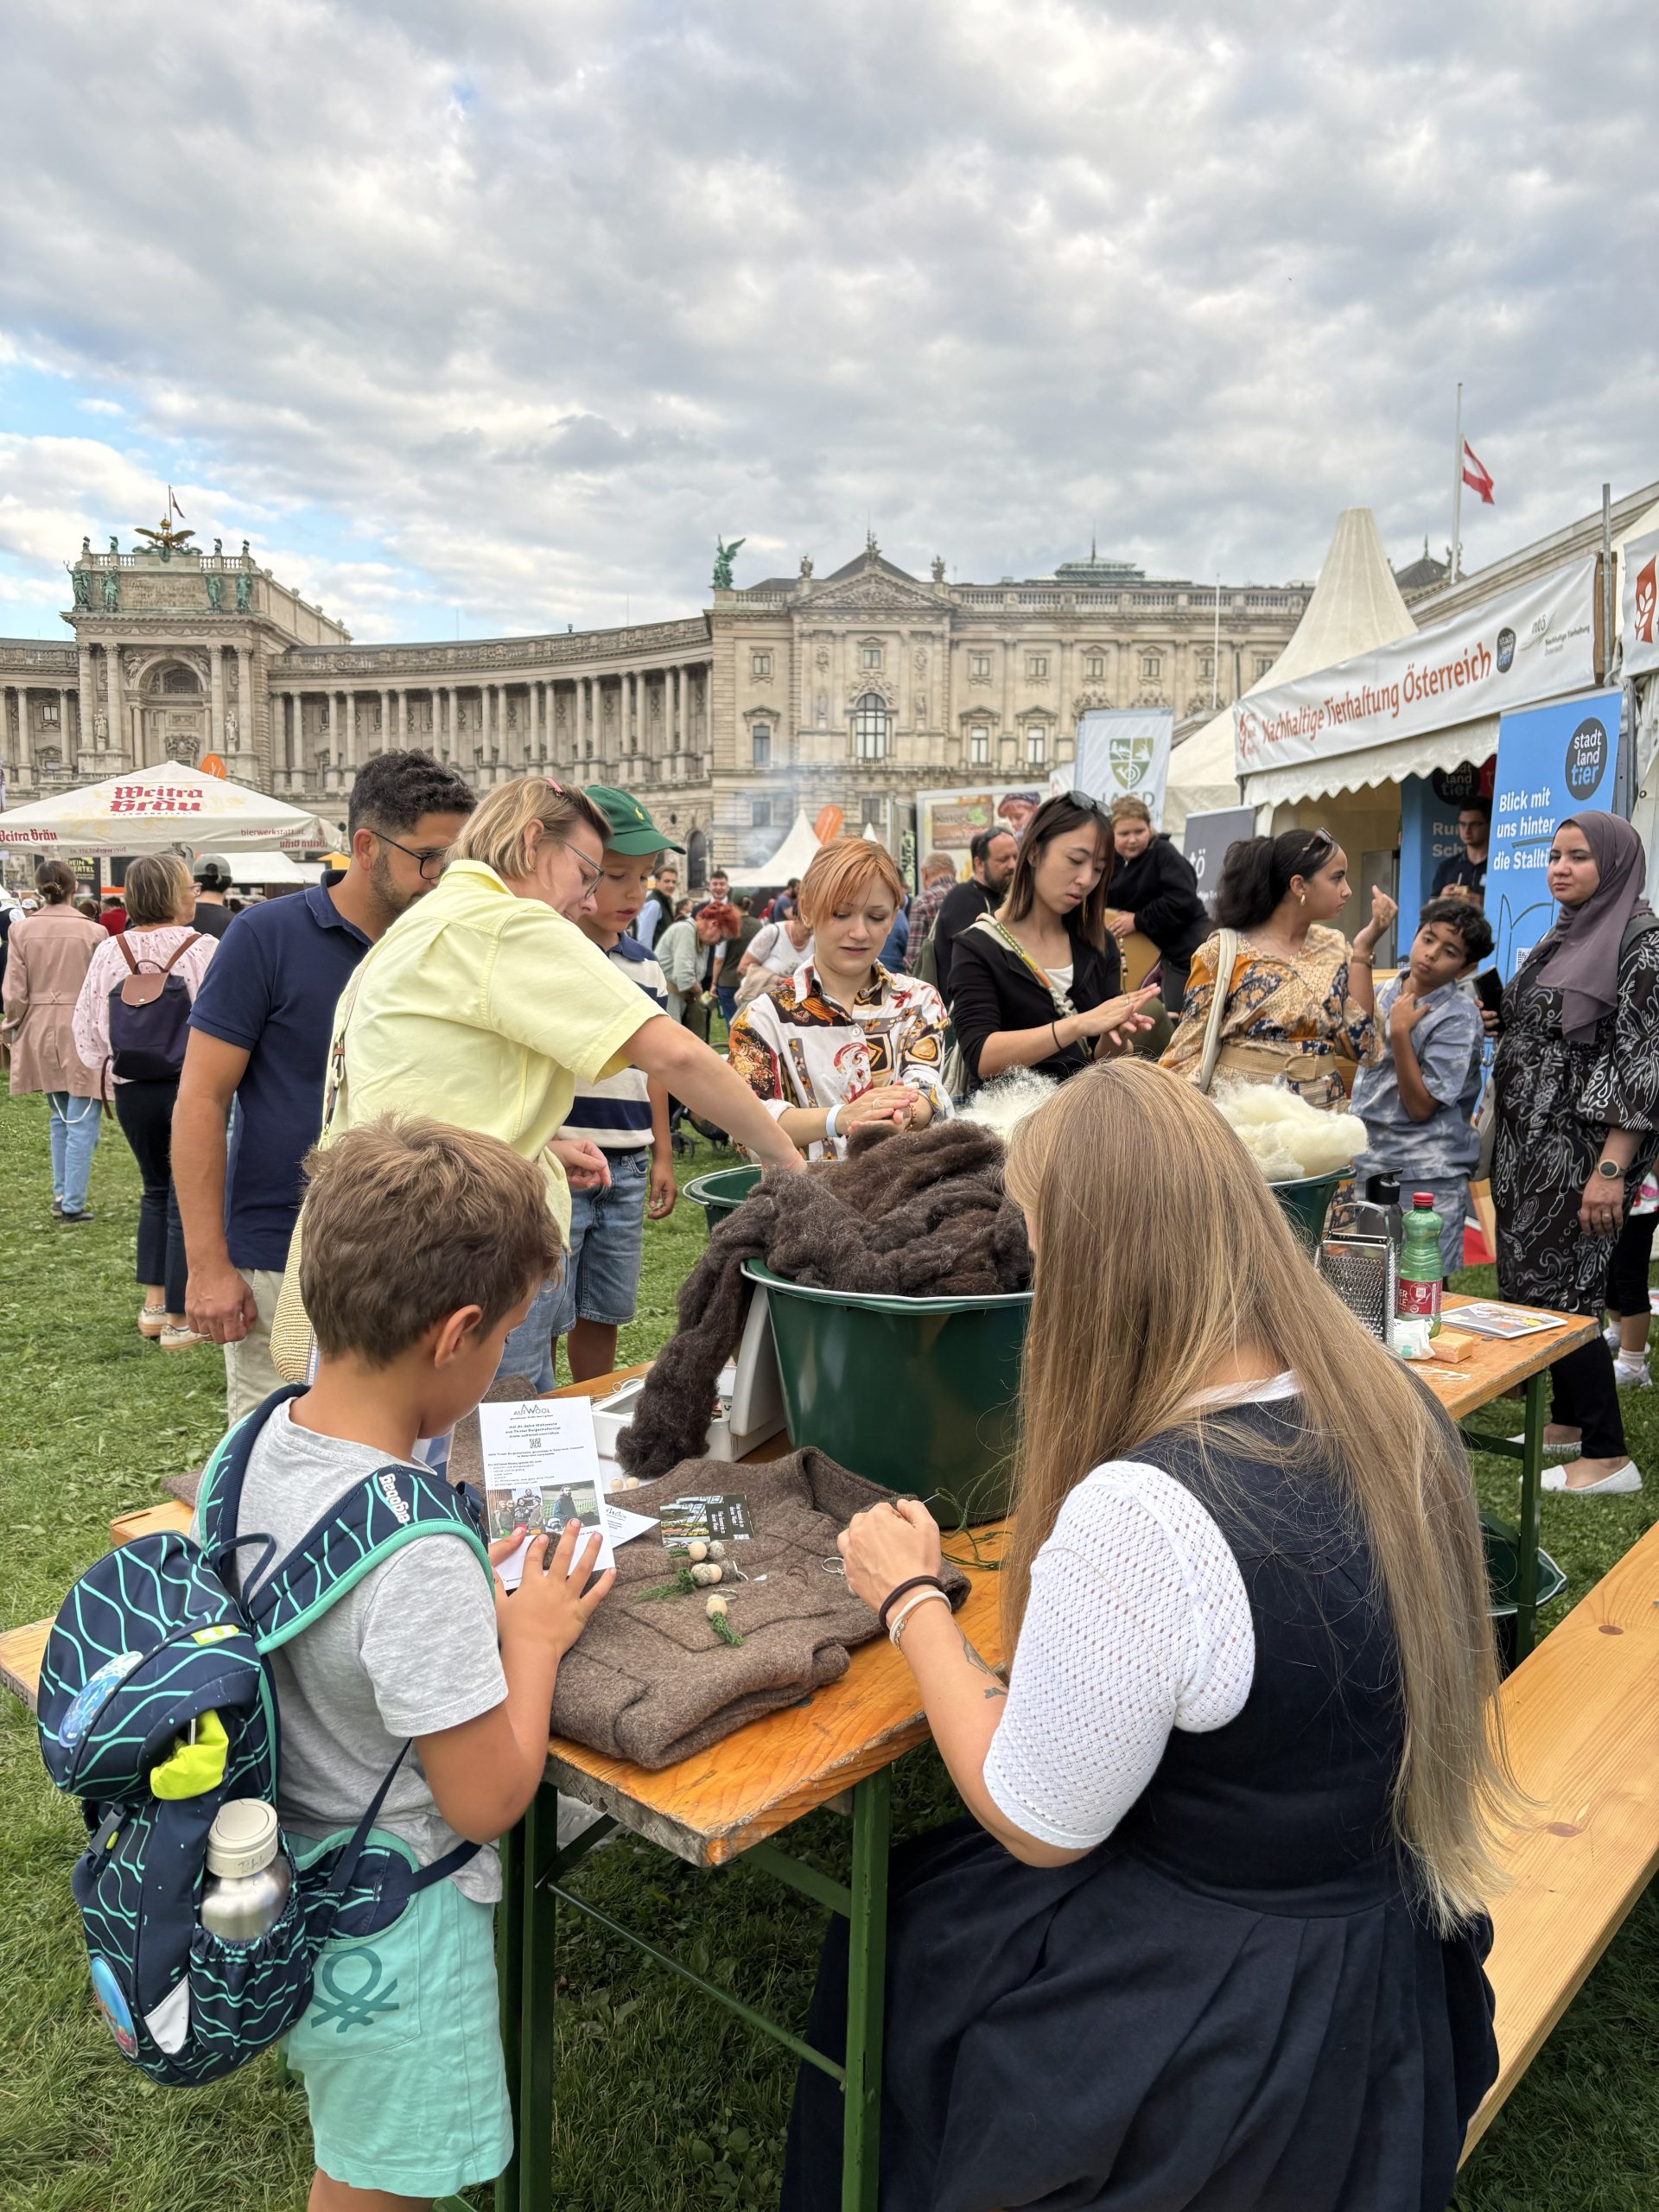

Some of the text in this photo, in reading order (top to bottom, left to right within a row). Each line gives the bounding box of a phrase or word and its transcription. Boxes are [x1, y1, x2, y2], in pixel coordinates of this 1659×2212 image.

[1262, 706, 1325, 744] Nachhaltige
[1324, 683, 1400, 728] Tierhaltung
[1403, 642, 1491, 703] Österreich
[1573, 728, 1602, 750] stadt
[1577, 747, 1601, 767] land
[1446, 773, 1472, 784] land
[1571, 764, 1599, 786] tier
[1441, 781, 1473, 796] tier
[1499, 785, 1551, 813] Blick mit
[110, 798, 202, 812] Bräu
[30, 829, 57, 842] Bräu
[1497, 816, 1555, 838] uns hinter
[1493, 851, 1510, 871] die
[378, 1473, 410, 1523] ergobag
